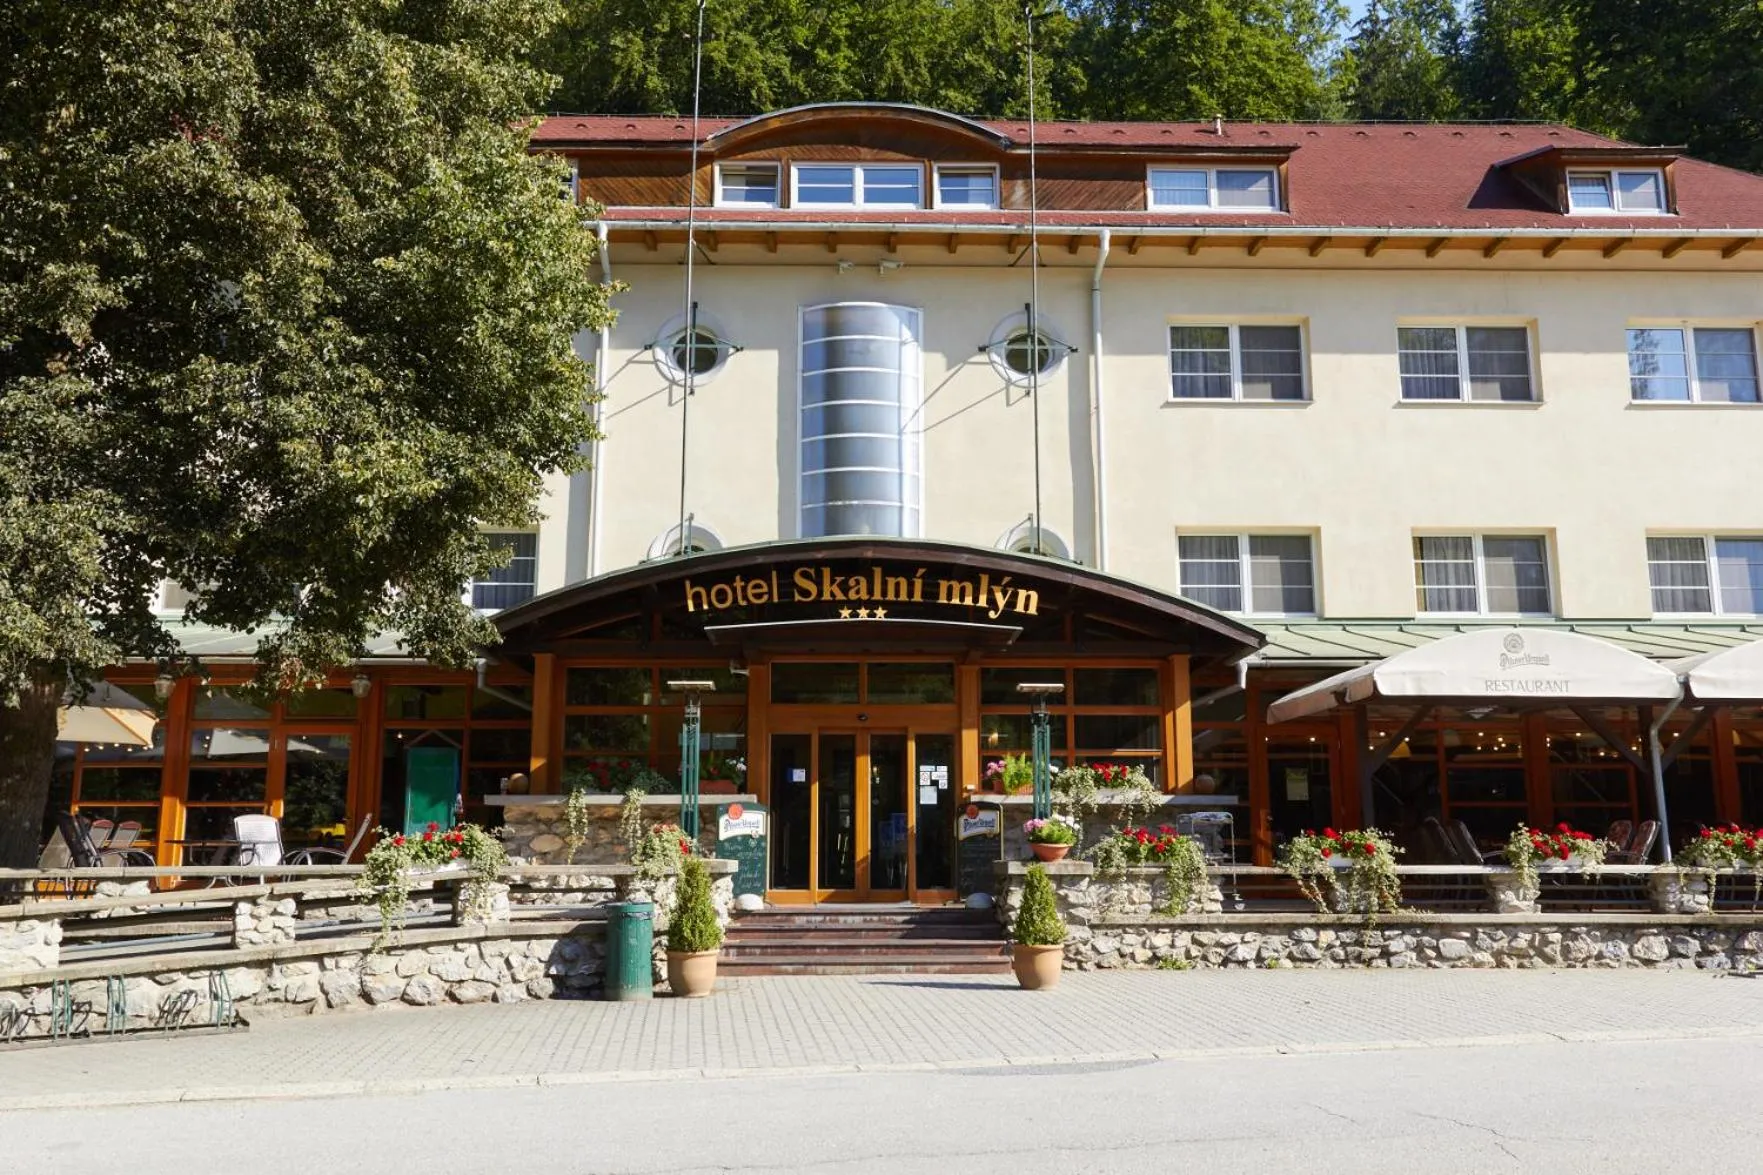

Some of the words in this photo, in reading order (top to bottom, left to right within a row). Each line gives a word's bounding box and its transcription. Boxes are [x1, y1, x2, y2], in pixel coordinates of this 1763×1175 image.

[684, 570, 778, 612] hotel
[793, 567, 927, 602] Skalní
[937, 573, 1038, 619] mlýn
[1485, 679, 1570, 692] RESTAURANT
